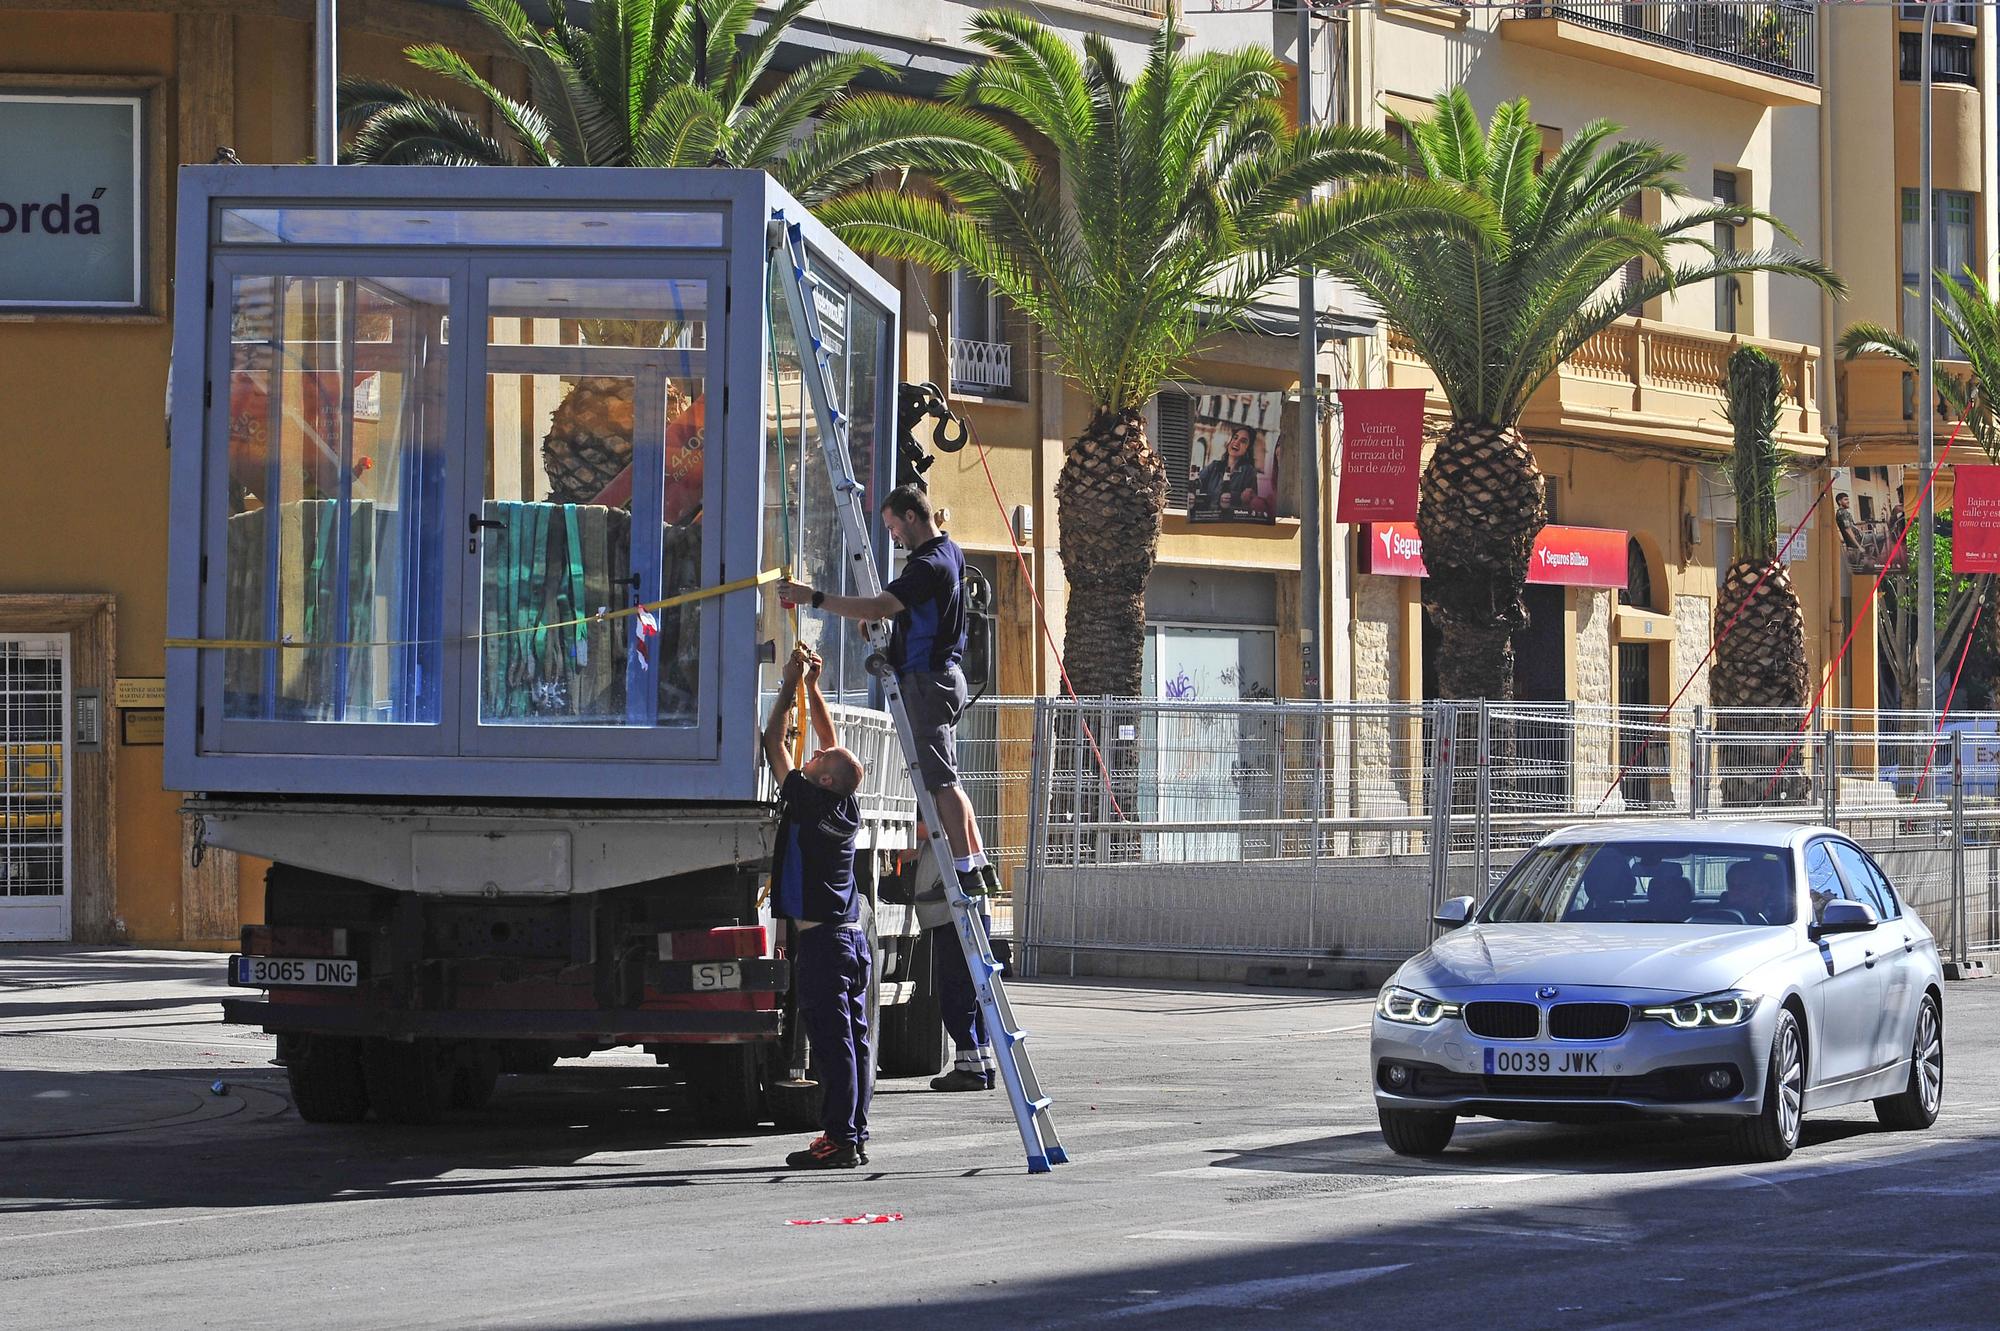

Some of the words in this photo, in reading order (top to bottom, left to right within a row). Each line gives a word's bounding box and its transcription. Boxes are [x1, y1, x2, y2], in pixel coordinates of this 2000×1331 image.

[0, 187, 107, 235] ordá
[1361, 422, 1397, 434] Venirte
[1350, 435, 1379, 447] arriba
[1380, 439, 1393, 447] en
[1395, 435, 1405, 447] la
[1351, 451, 1385, 460] terraza
[1387, 448, 1404, 460] del
[1347, 461, 1364, 473] bar
[1365, 461, 1378, 473] de
[1380, 461, 1406, 476] abajo
[1967, 497, 1989, 508] Bajar
[1990, 499, 1996, 507] a
[1962, 506, 1982, 517] calle
[1982, 510, 1988, 519] y
[1959, 520, 1979, 528] como
[1980, 520, 1991, 528] en
[1393, 532, 1424, 560] Segur
[1546, 550, 1570, 567] Seguros
[1569, 551, 1589, 567] Bilbao
[255, 962, 305, 981] 3065
[315, 963, 353, 983] DNG
[700, 965, 735, 987] SP
[1499, 1052, 1551, 1073] 0039
[1558, 1052, 1599, 1074] JWK
